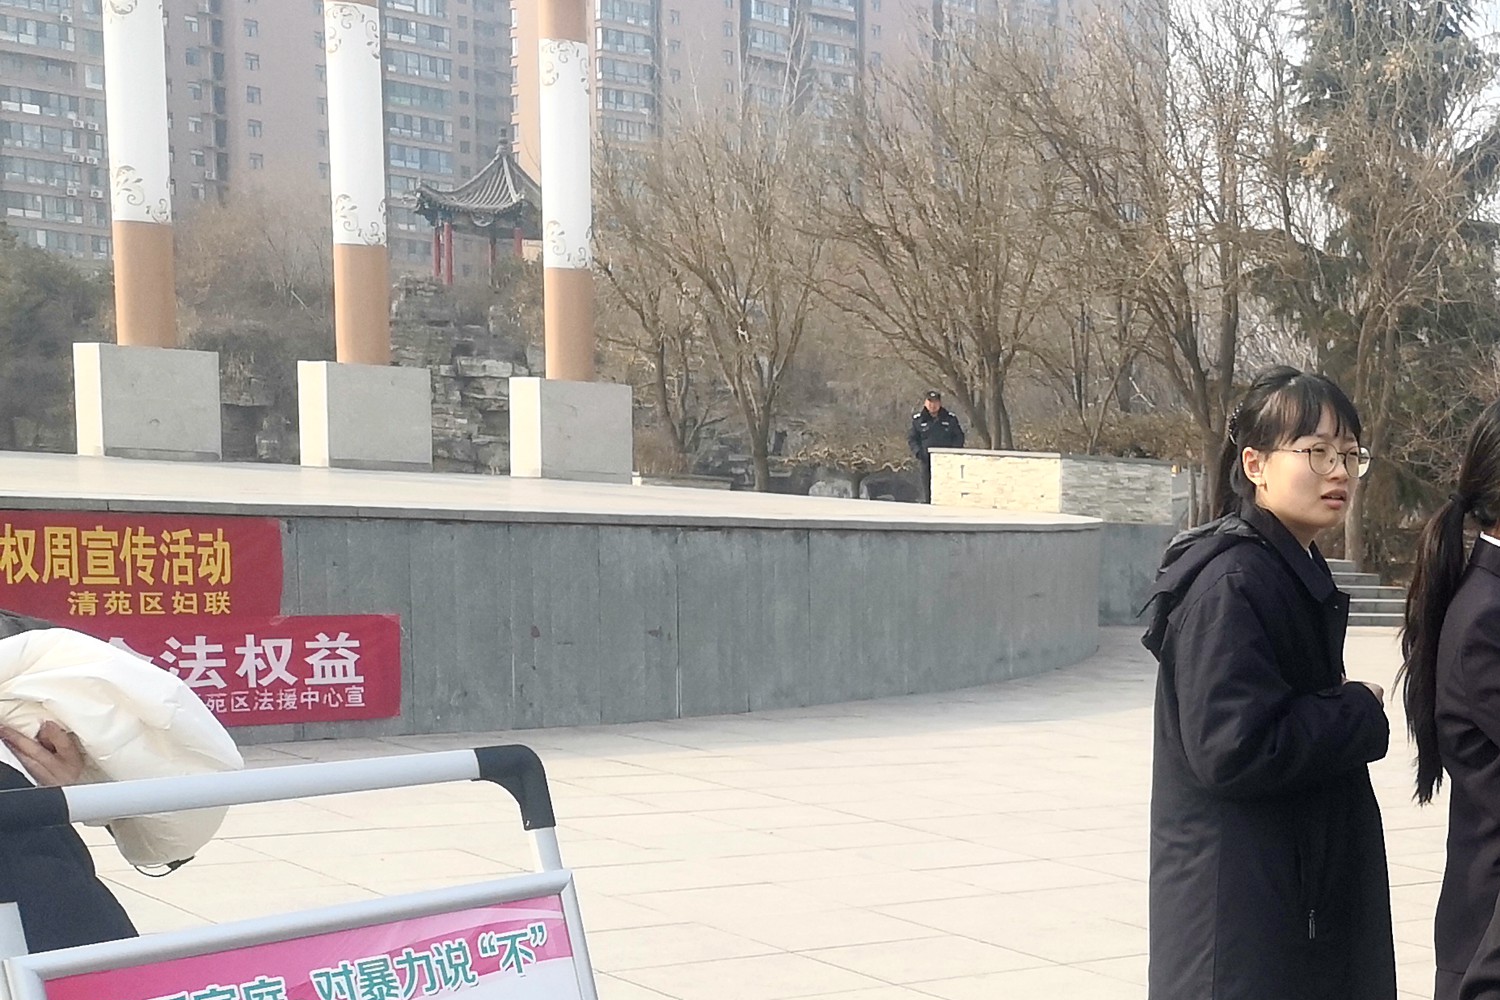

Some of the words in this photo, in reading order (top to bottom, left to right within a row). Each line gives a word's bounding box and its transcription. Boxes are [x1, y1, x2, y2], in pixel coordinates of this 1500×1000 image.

[0, 523, 232, 586] 权周宣传活动
[68, 591, 231, 616] 清苑区妇联
[107, 632, 365, 689] 法权益
[196, 685, 365, 713] 苑区法援中心宣
